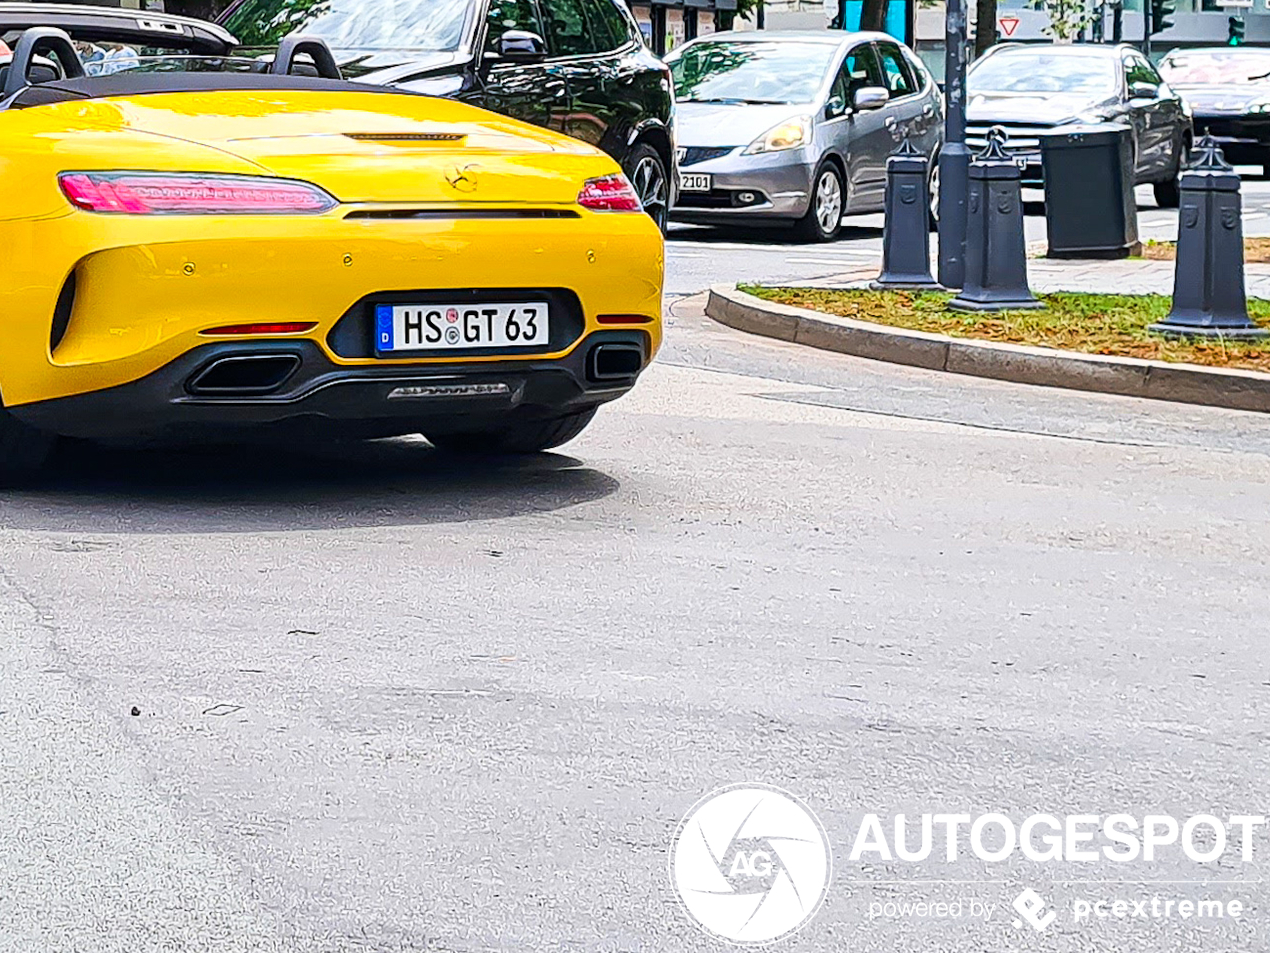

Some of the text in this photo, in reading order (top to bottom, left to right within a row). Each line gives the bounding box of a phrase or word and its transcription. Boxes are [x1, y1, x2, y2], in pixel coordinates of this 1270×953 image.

[682, 176, 709, 188] 2101
[381, 309, 537, 344] D HS GT 63
